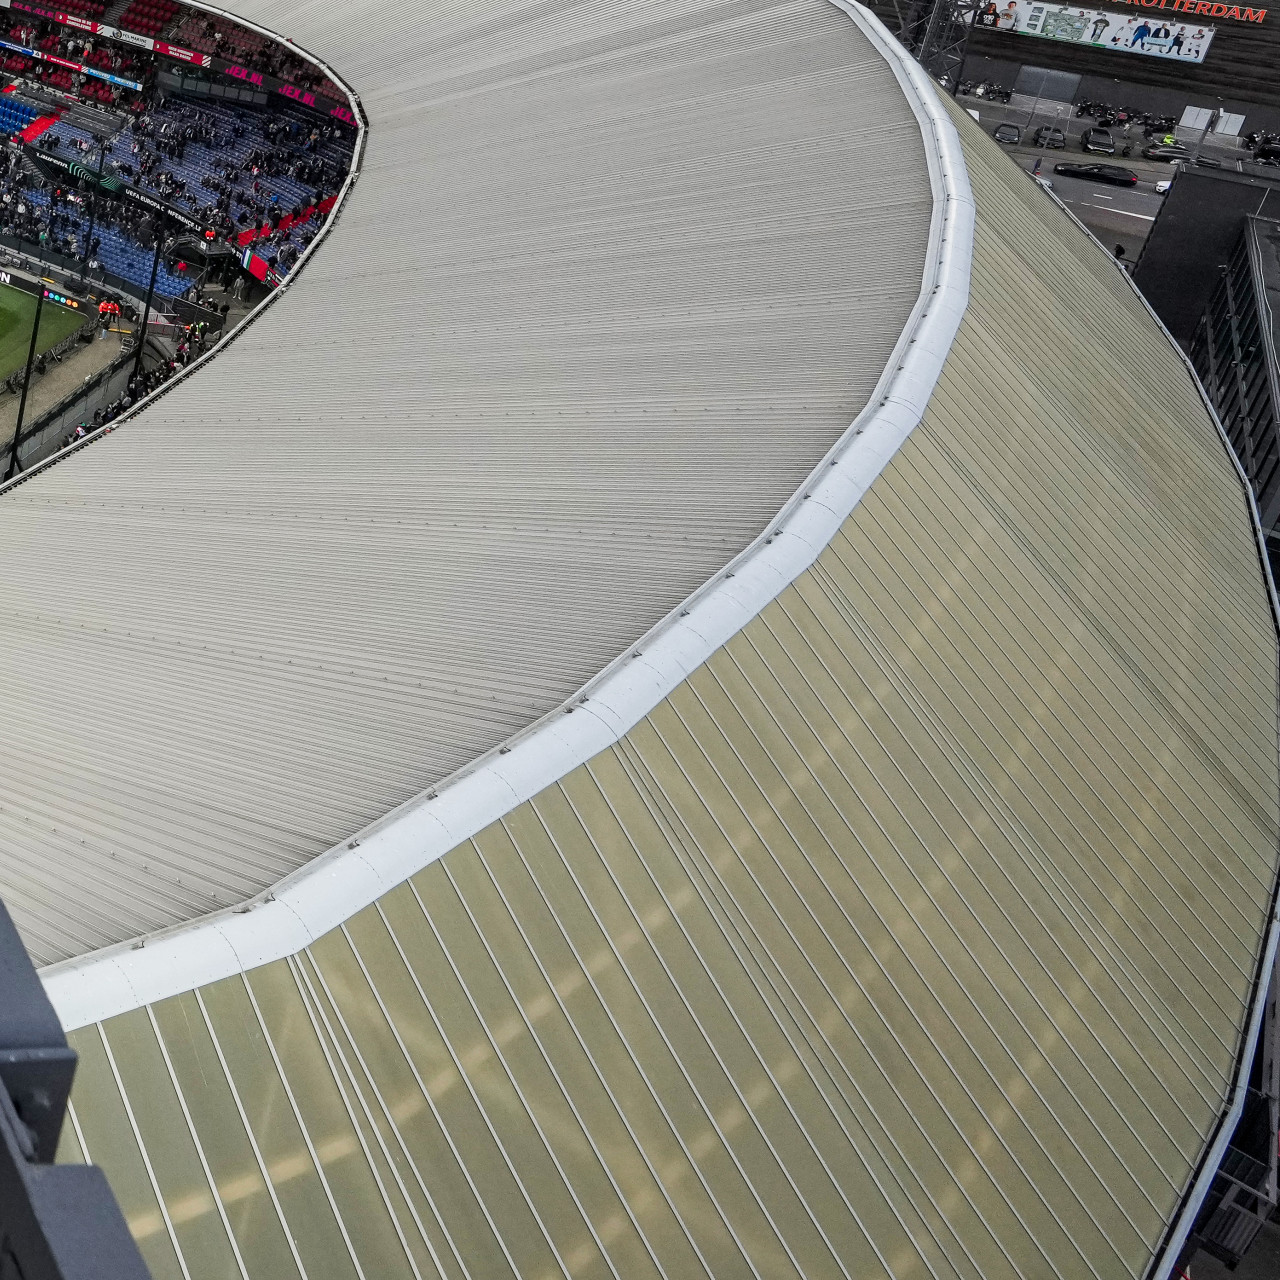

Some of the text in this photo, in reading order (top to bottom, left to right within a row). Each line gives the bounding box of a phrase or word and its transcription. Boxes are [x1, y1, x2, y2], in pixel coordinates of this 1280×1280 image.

[225, 65, 263, 86] JEX.NL
[279, 84, 315, 107] JEX.NL
[125, 188, 140, 201] UEFA
[140, 195, 161, 210] EUROPA
[160, 205, 195, 228] CNFERENCE
